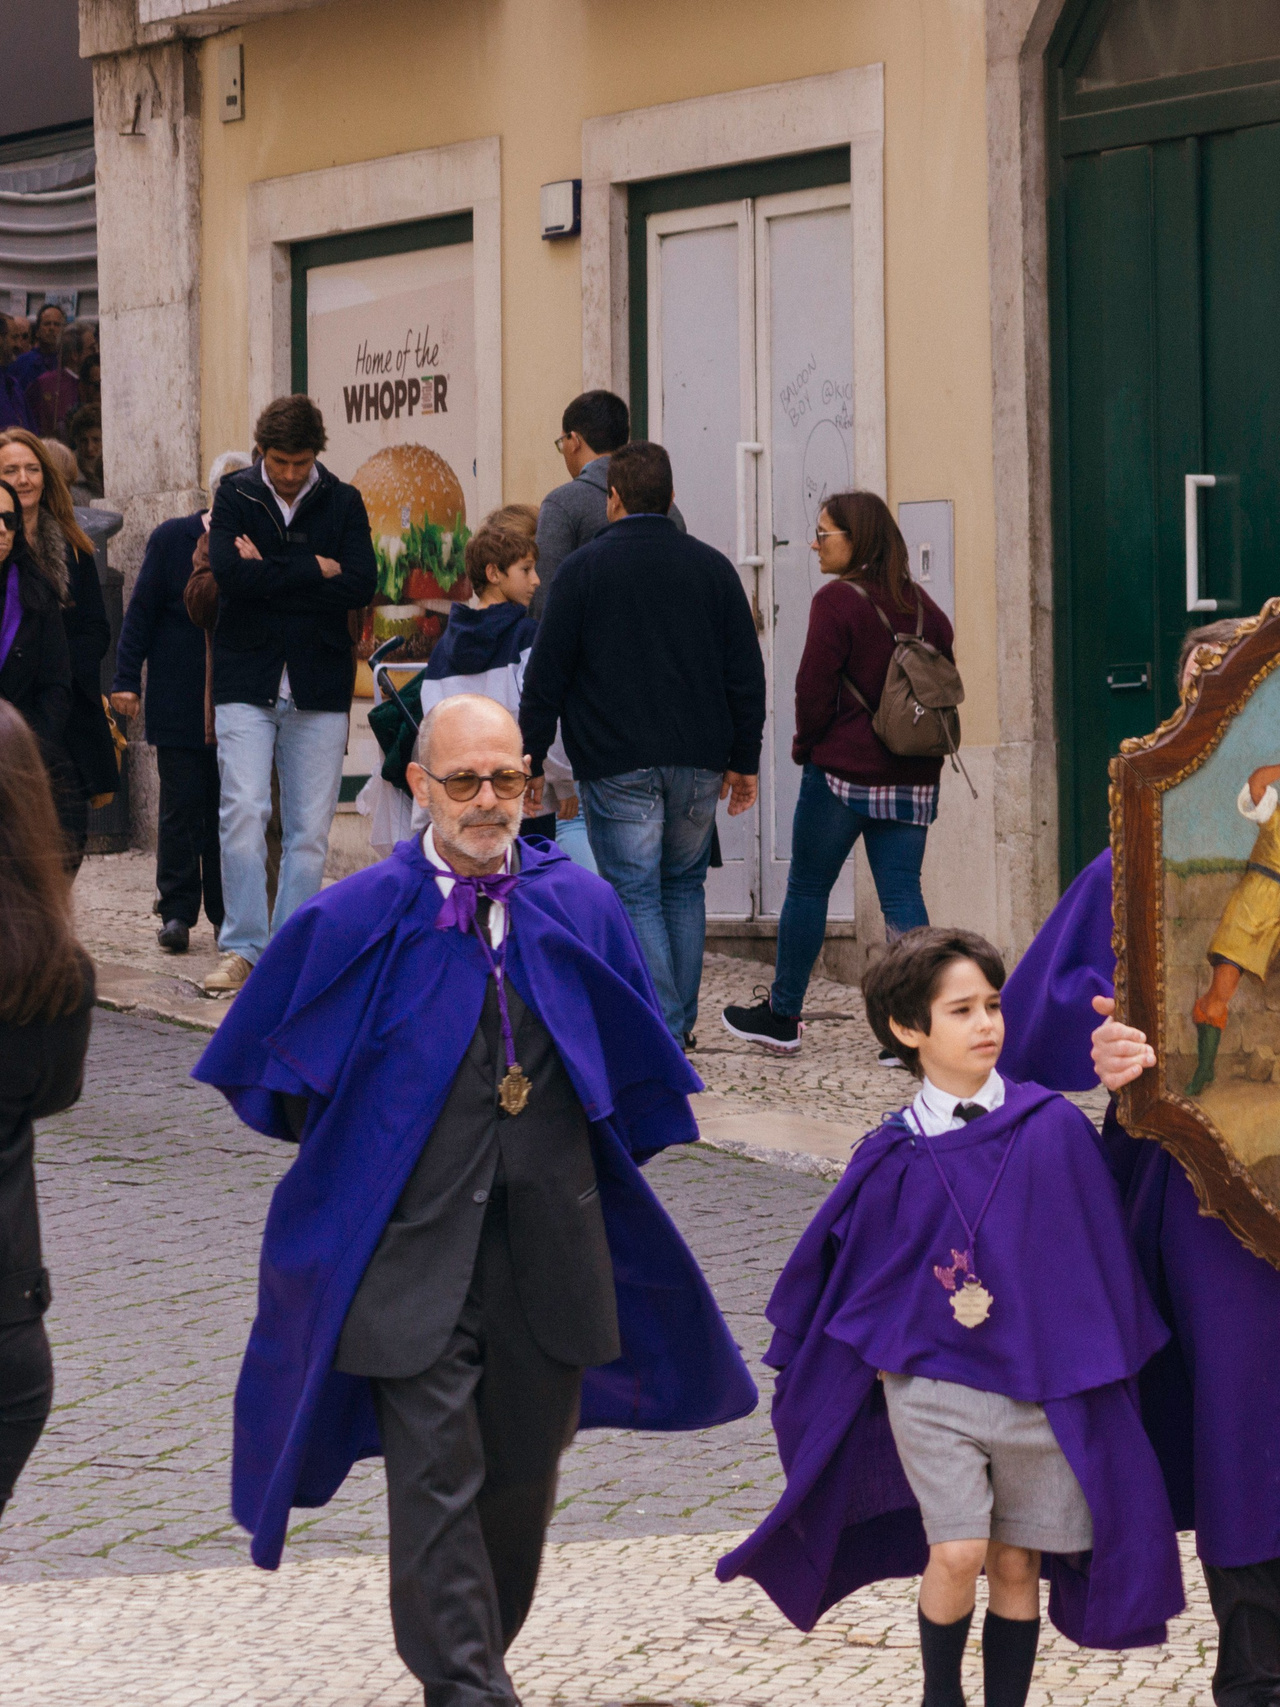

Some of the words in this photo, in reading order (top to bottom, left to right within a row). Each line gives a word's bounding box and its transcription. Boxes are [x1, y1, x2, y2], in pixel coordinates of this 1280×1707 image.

[355, 339, 392, 376] Home
[396, 328, 414, 378] of
[415, 324, 439, 368] the
